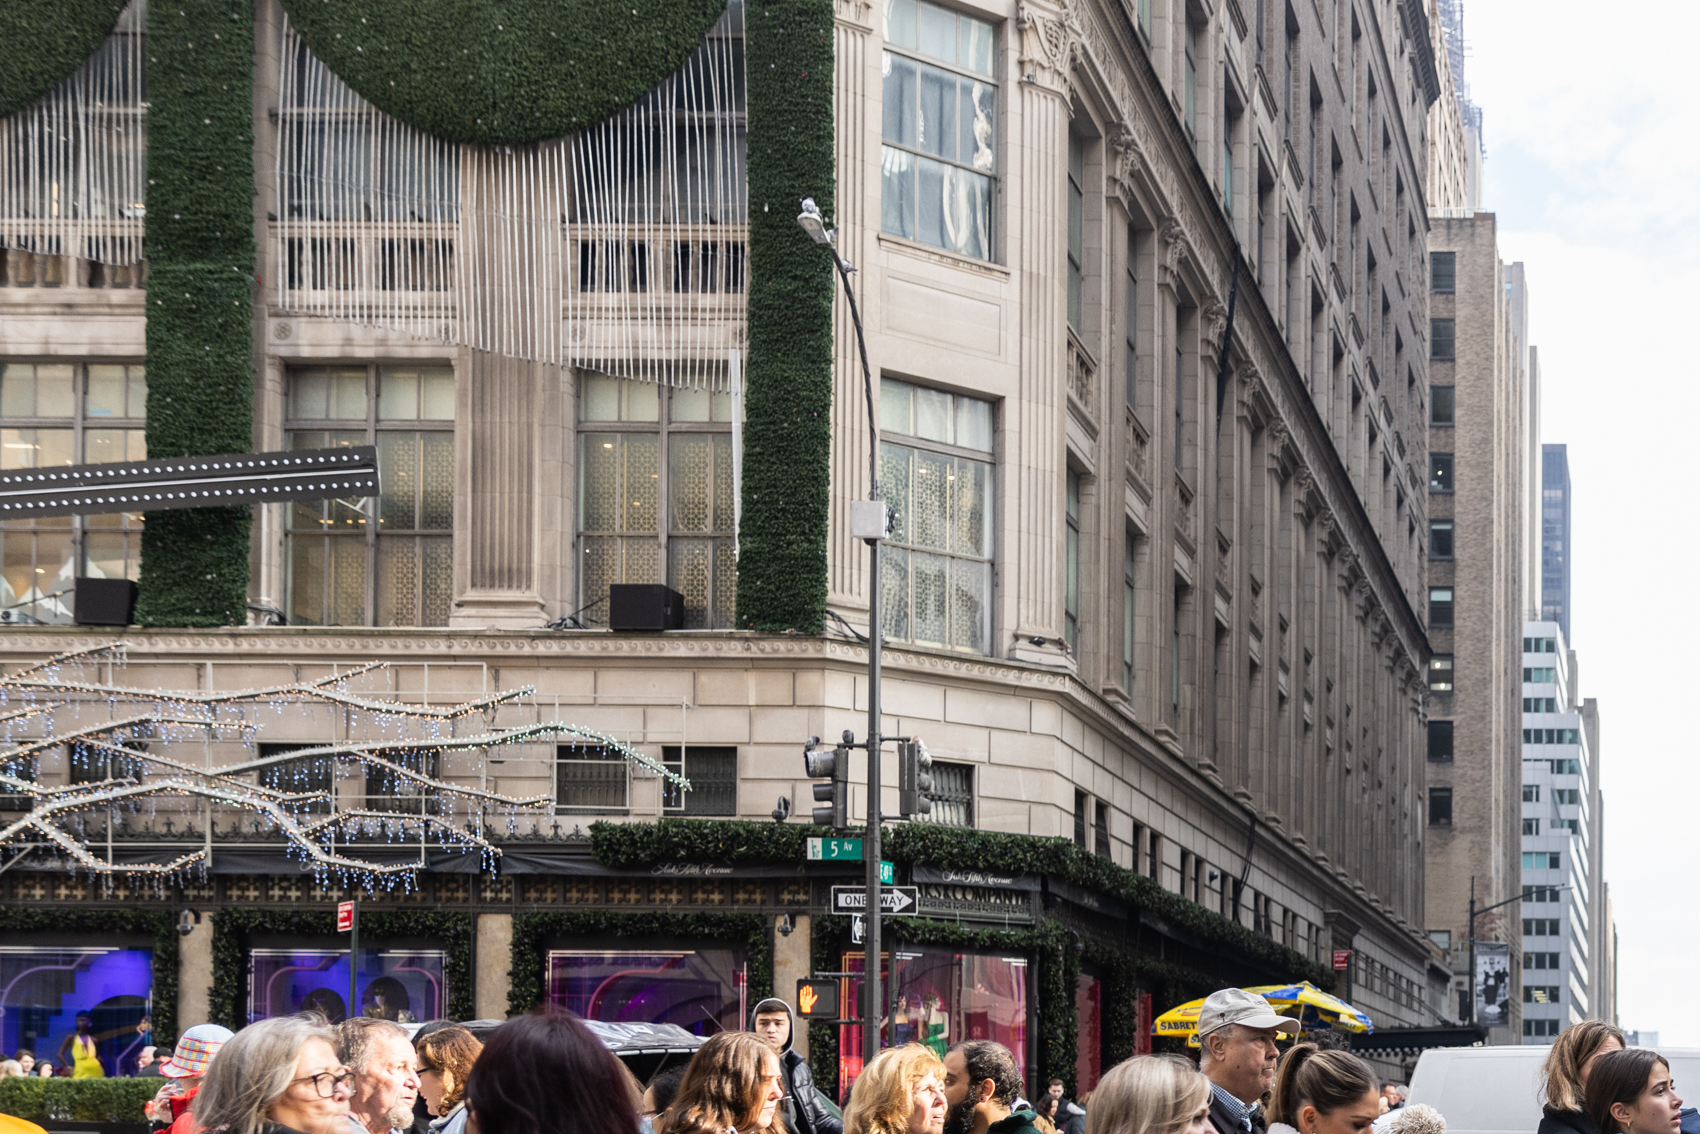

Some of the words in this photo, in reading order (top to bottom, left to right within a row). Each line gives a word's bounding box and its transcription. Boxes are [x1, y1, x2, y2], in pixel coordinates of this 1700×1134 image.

[831, 841, 838, 857] 5
[843, 841, 853, 851] Av
[845, 896, 866, 906] ONE
[880, 896, 904, 906] WAY
[1160, 1020, 1197, 1031] SABRET
